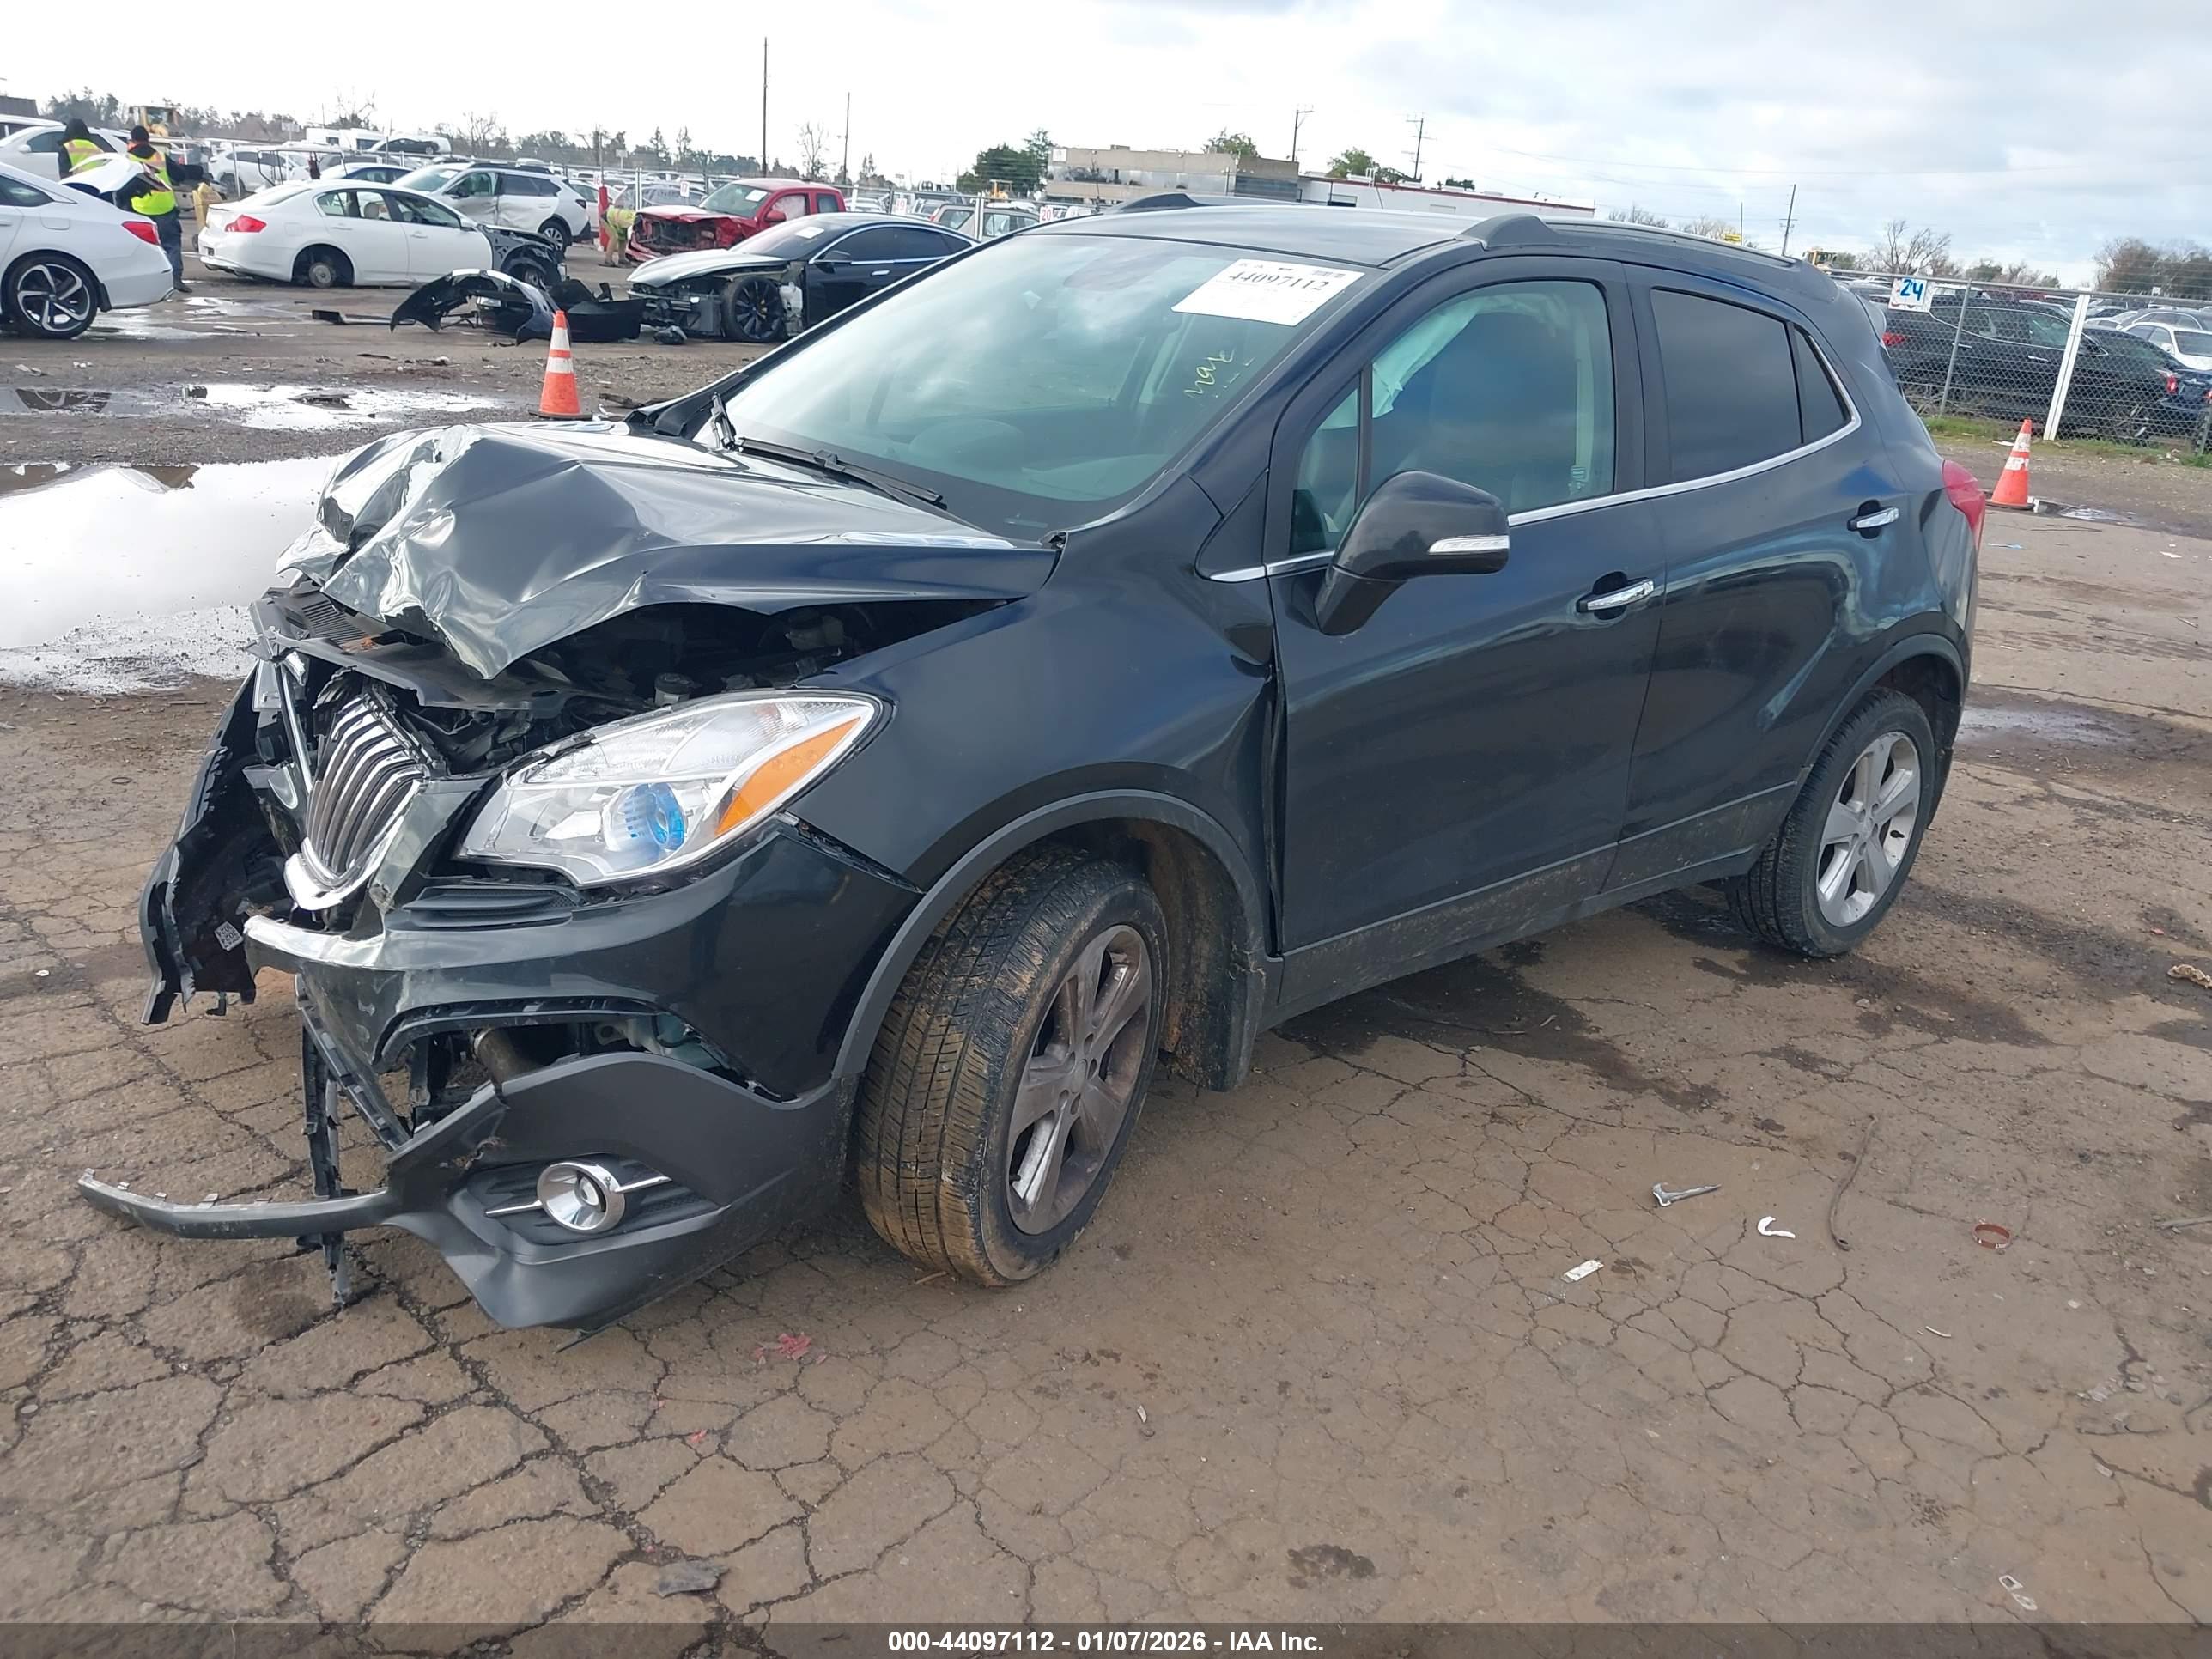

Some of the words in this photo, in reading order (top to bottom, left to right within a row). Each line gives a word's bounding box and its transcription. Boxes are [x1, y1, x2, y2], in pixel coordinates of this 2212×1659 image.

[1042, 209, 1052, 221] 20
[1228, 270, 1330, 291] 44097112
[1899, 279, 1923, 301] 24
